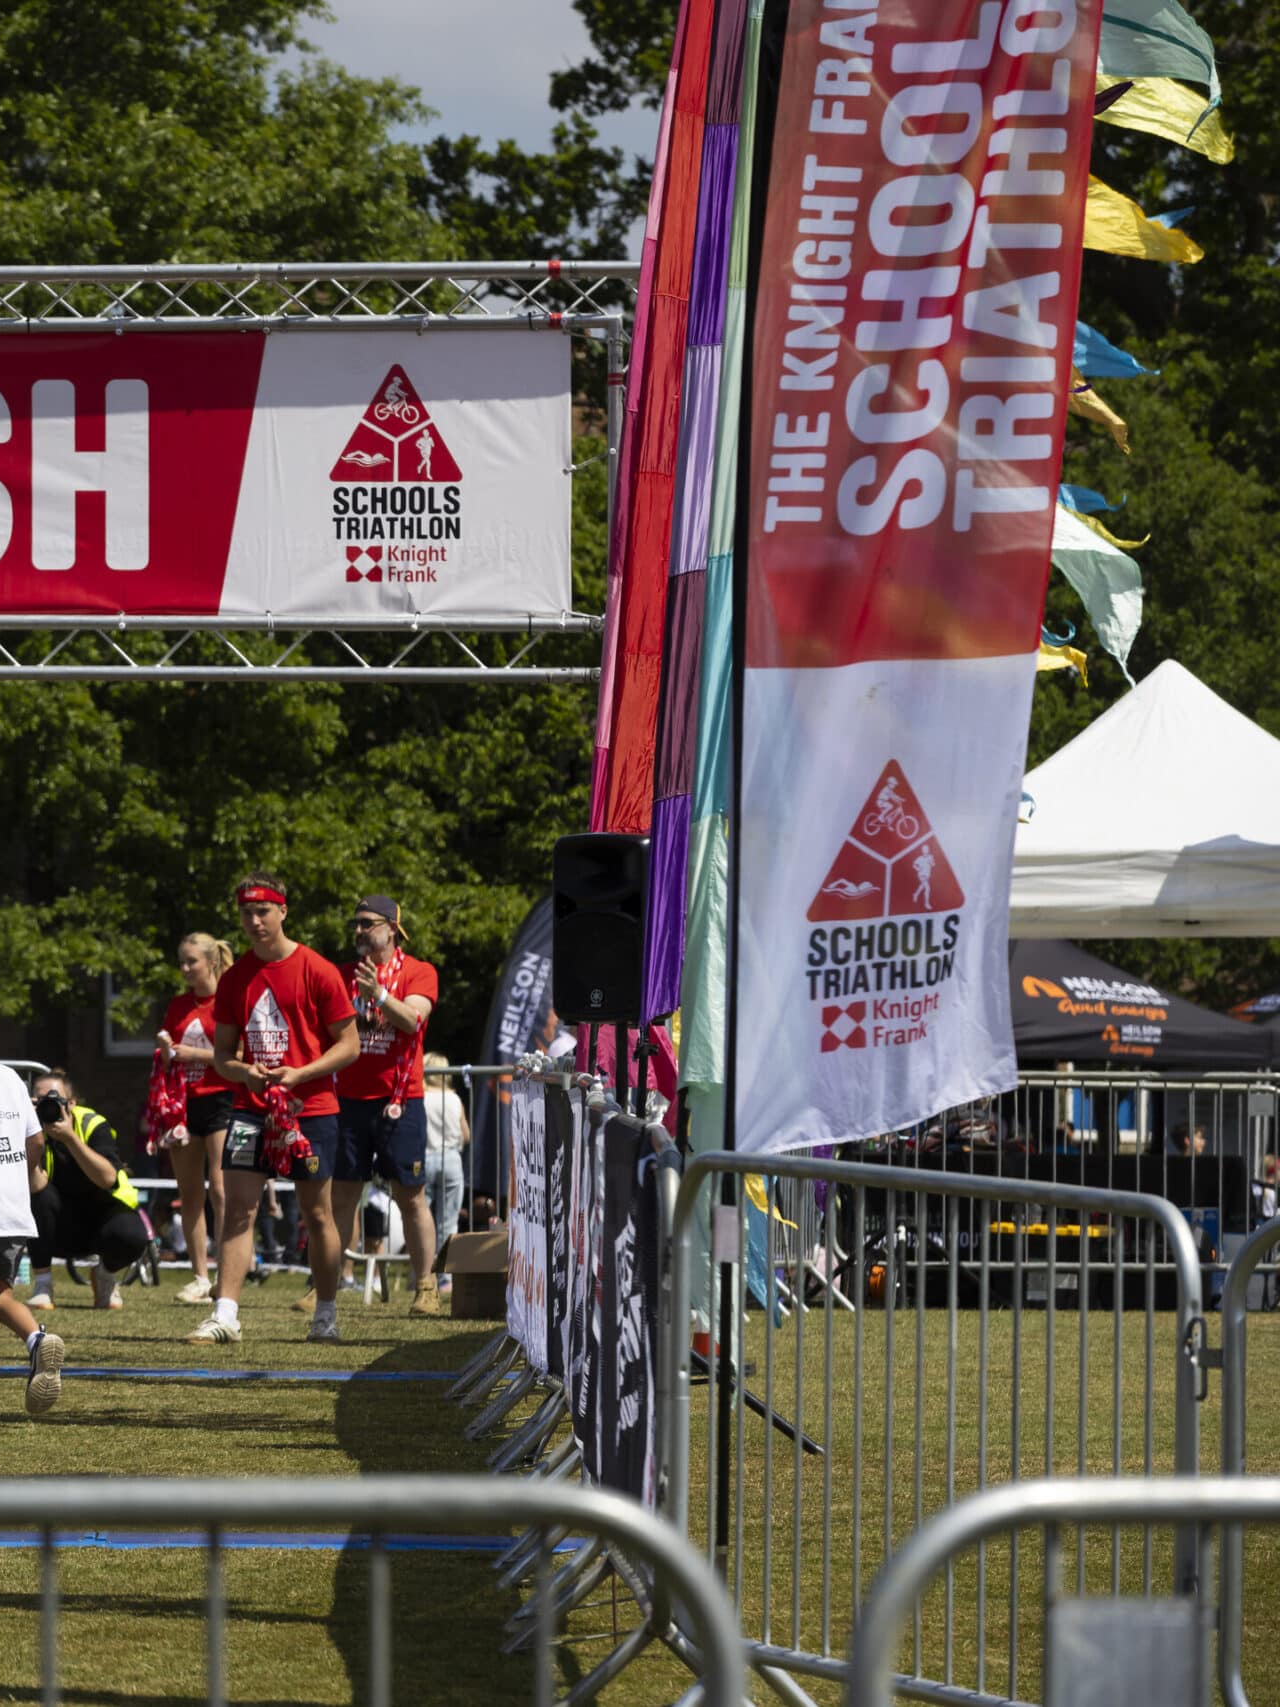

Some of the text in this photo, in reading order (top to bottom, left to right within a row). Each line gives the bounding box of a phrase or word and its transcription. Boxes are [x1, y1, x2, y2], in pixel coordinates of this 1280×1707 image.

[763, 0, 879, 533] THE KNIGHT FRA
[837, 0, 1003, 536] SCHOOL
[953, 0, 1077, 533] TRIATHLO
[332, 485, 461, 515] SCHOOLS
[332, 515, 461, 540] TRIATHLON
[387, 543, 448, 566] Knight
[387, 565, 438, 583] Frank
[807, 914, 960, 967] SCHOOLS
[806, 951, 955, 1000] TRIATHLON
[498, 951, 541, 1054] NEILSON
[873, 992, 940, 1023] Knight
[248, 1032, 288, 1043] SCHOOLS
[873, 1022, 928, 1047] Frank
